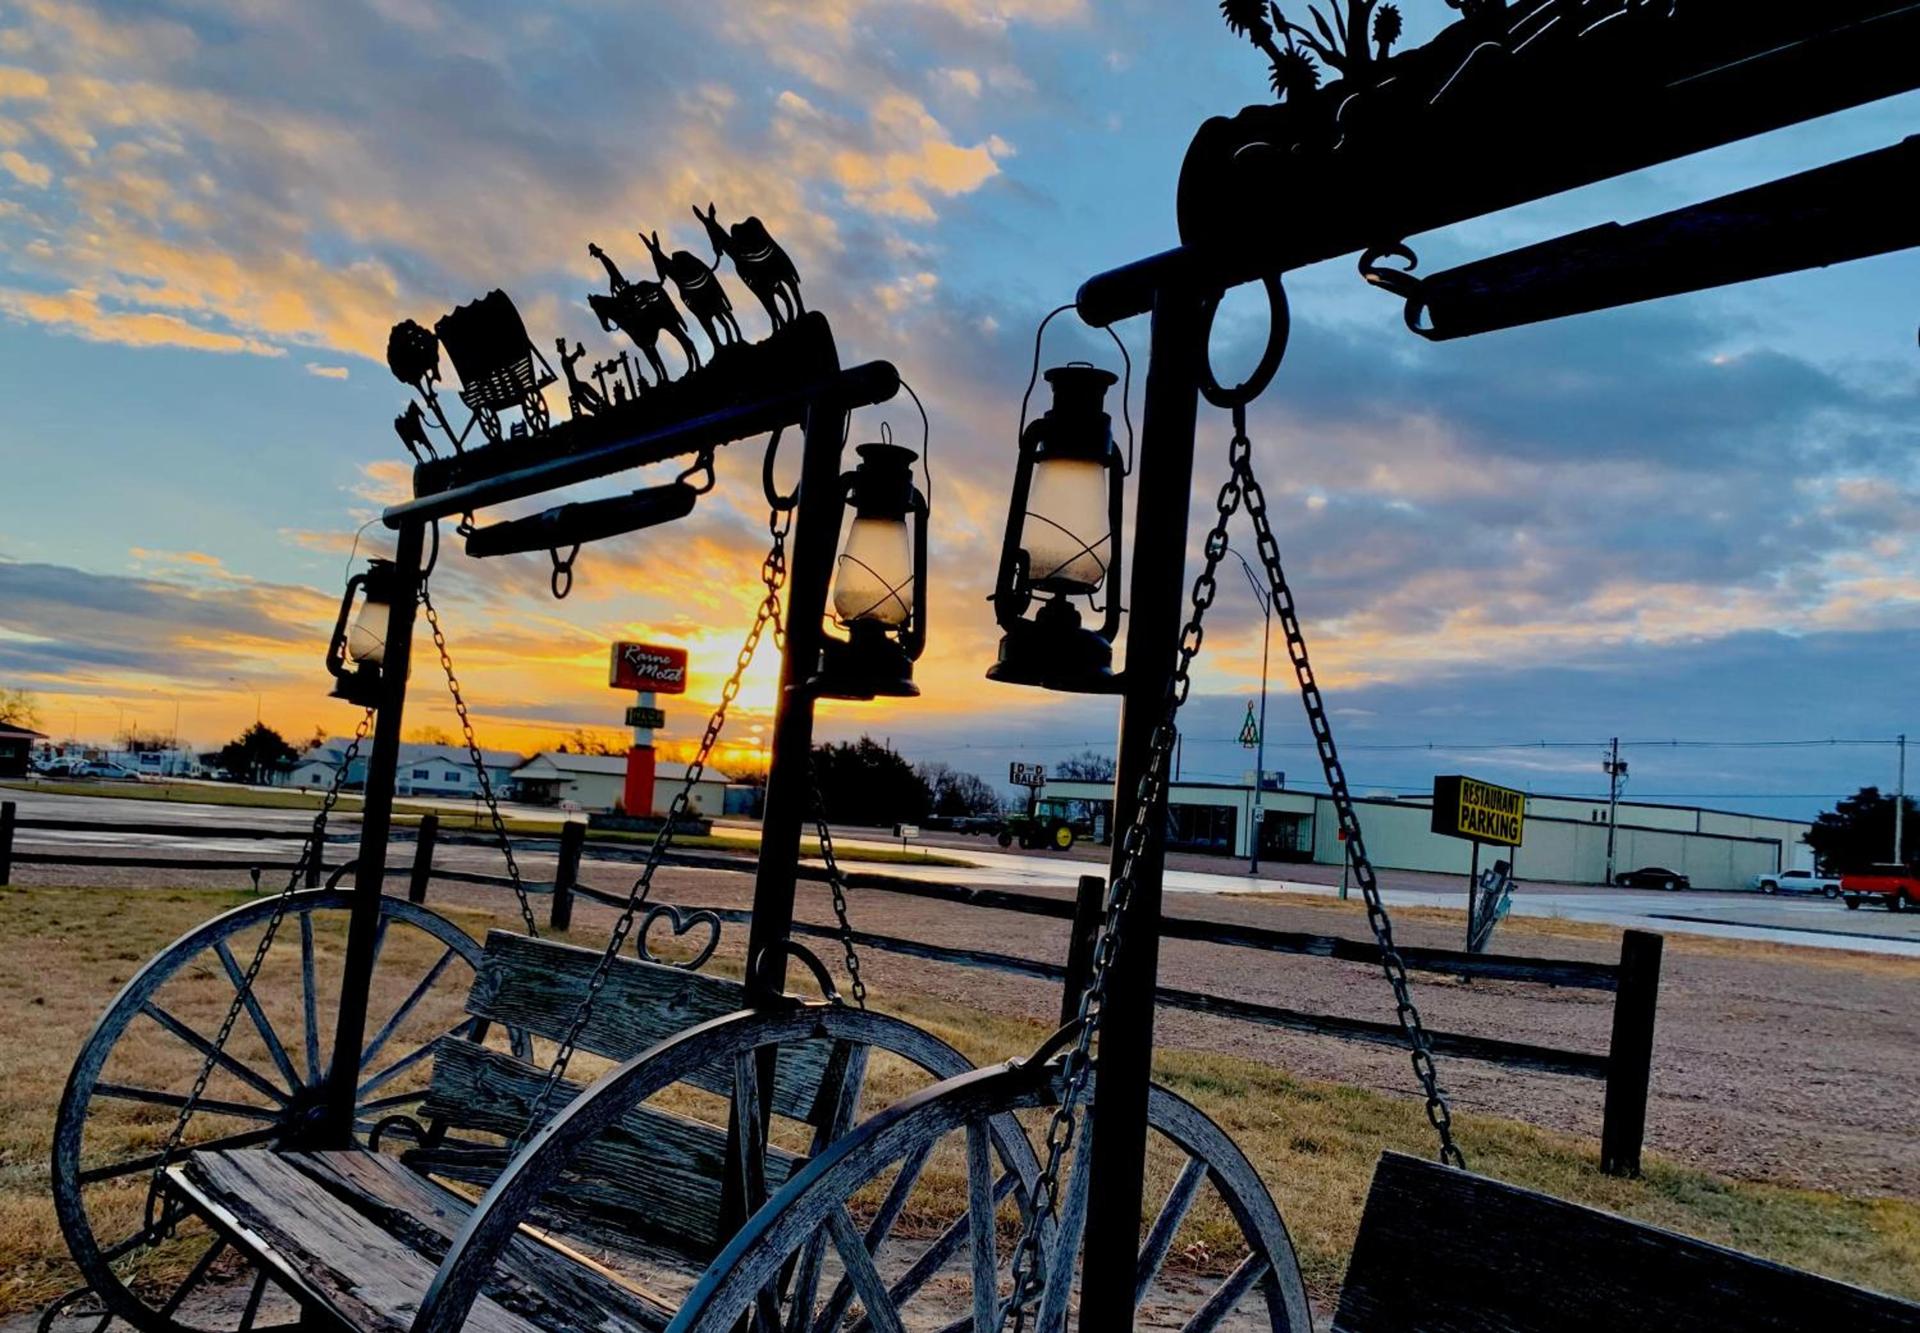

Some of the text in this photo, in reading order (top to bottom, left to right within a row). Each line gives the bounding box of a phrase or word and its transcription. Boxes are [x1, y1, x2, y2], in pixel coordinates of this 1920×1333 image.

[636, 663, 684, 682] Motel
[1014, 772, 1045, 786] SALES
[1463, 781, 1520, 816] RESTAURANT
[1461, 805, 1519, 841] PARKING
